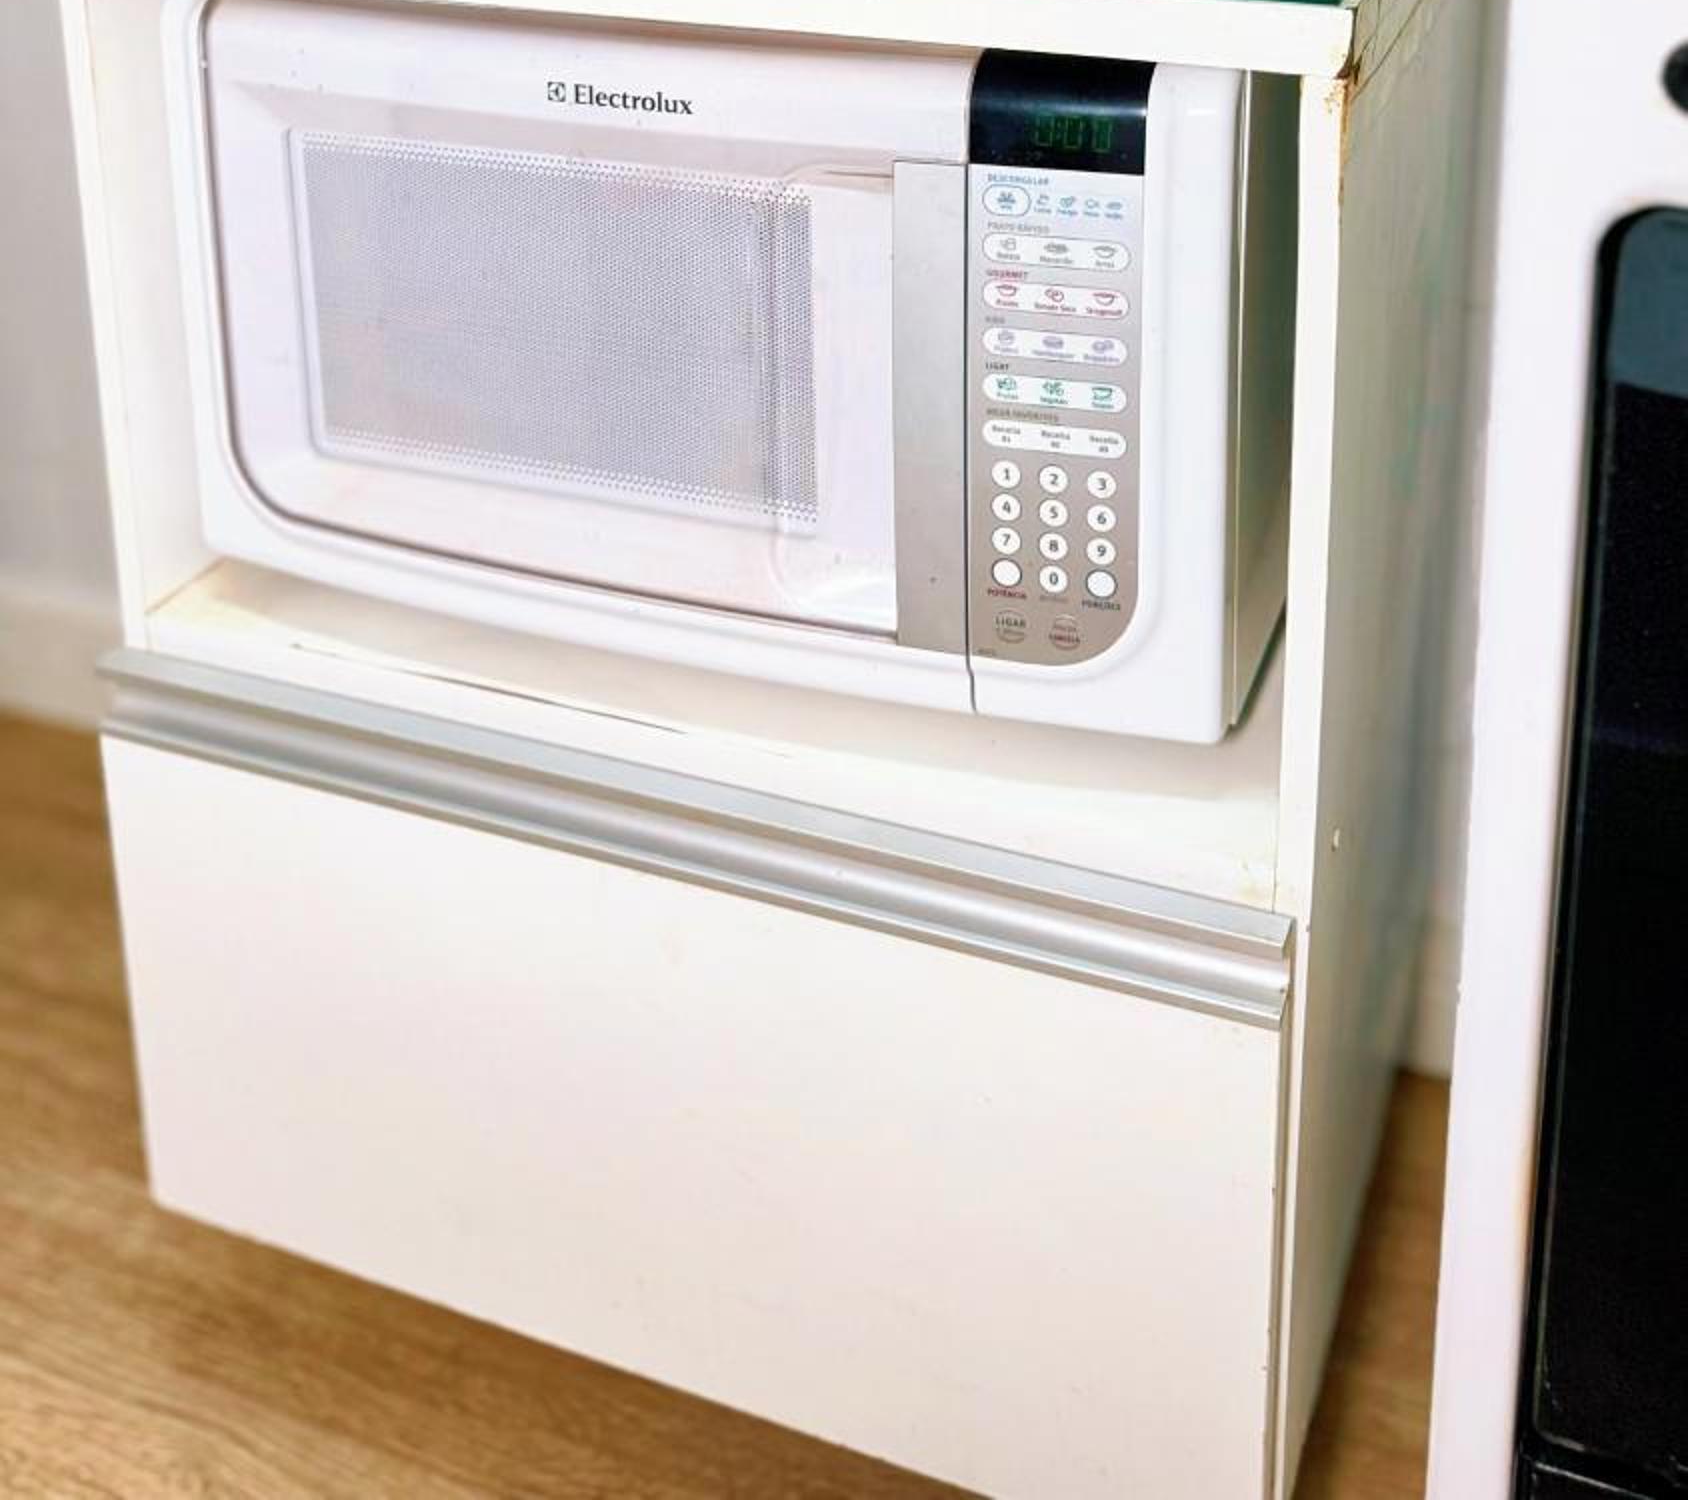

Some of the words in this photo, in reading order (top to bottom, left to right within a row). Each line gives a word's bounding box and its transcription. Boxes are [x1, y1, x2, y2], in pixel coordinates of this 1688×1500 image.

[574, 84, 693, 115] Electrolux
[1003, 468, 1011, 480] 1
[1048, 473, 1059, 486] 2
[1097, 478, 1107, 491] 3
[1001, 500, 1012, 514] 4
[1048, 506, 1059, 519] 5
[1096, 512, 1107, 525] 6
[1001, 534, 1011, 547] 7
[1048, 540, 1059, 553] 8
[1097, 545, 1107, 558] 9
[1049, 572, 1059, 586] 0
[995, 616, 1026, 629] LIGAR
